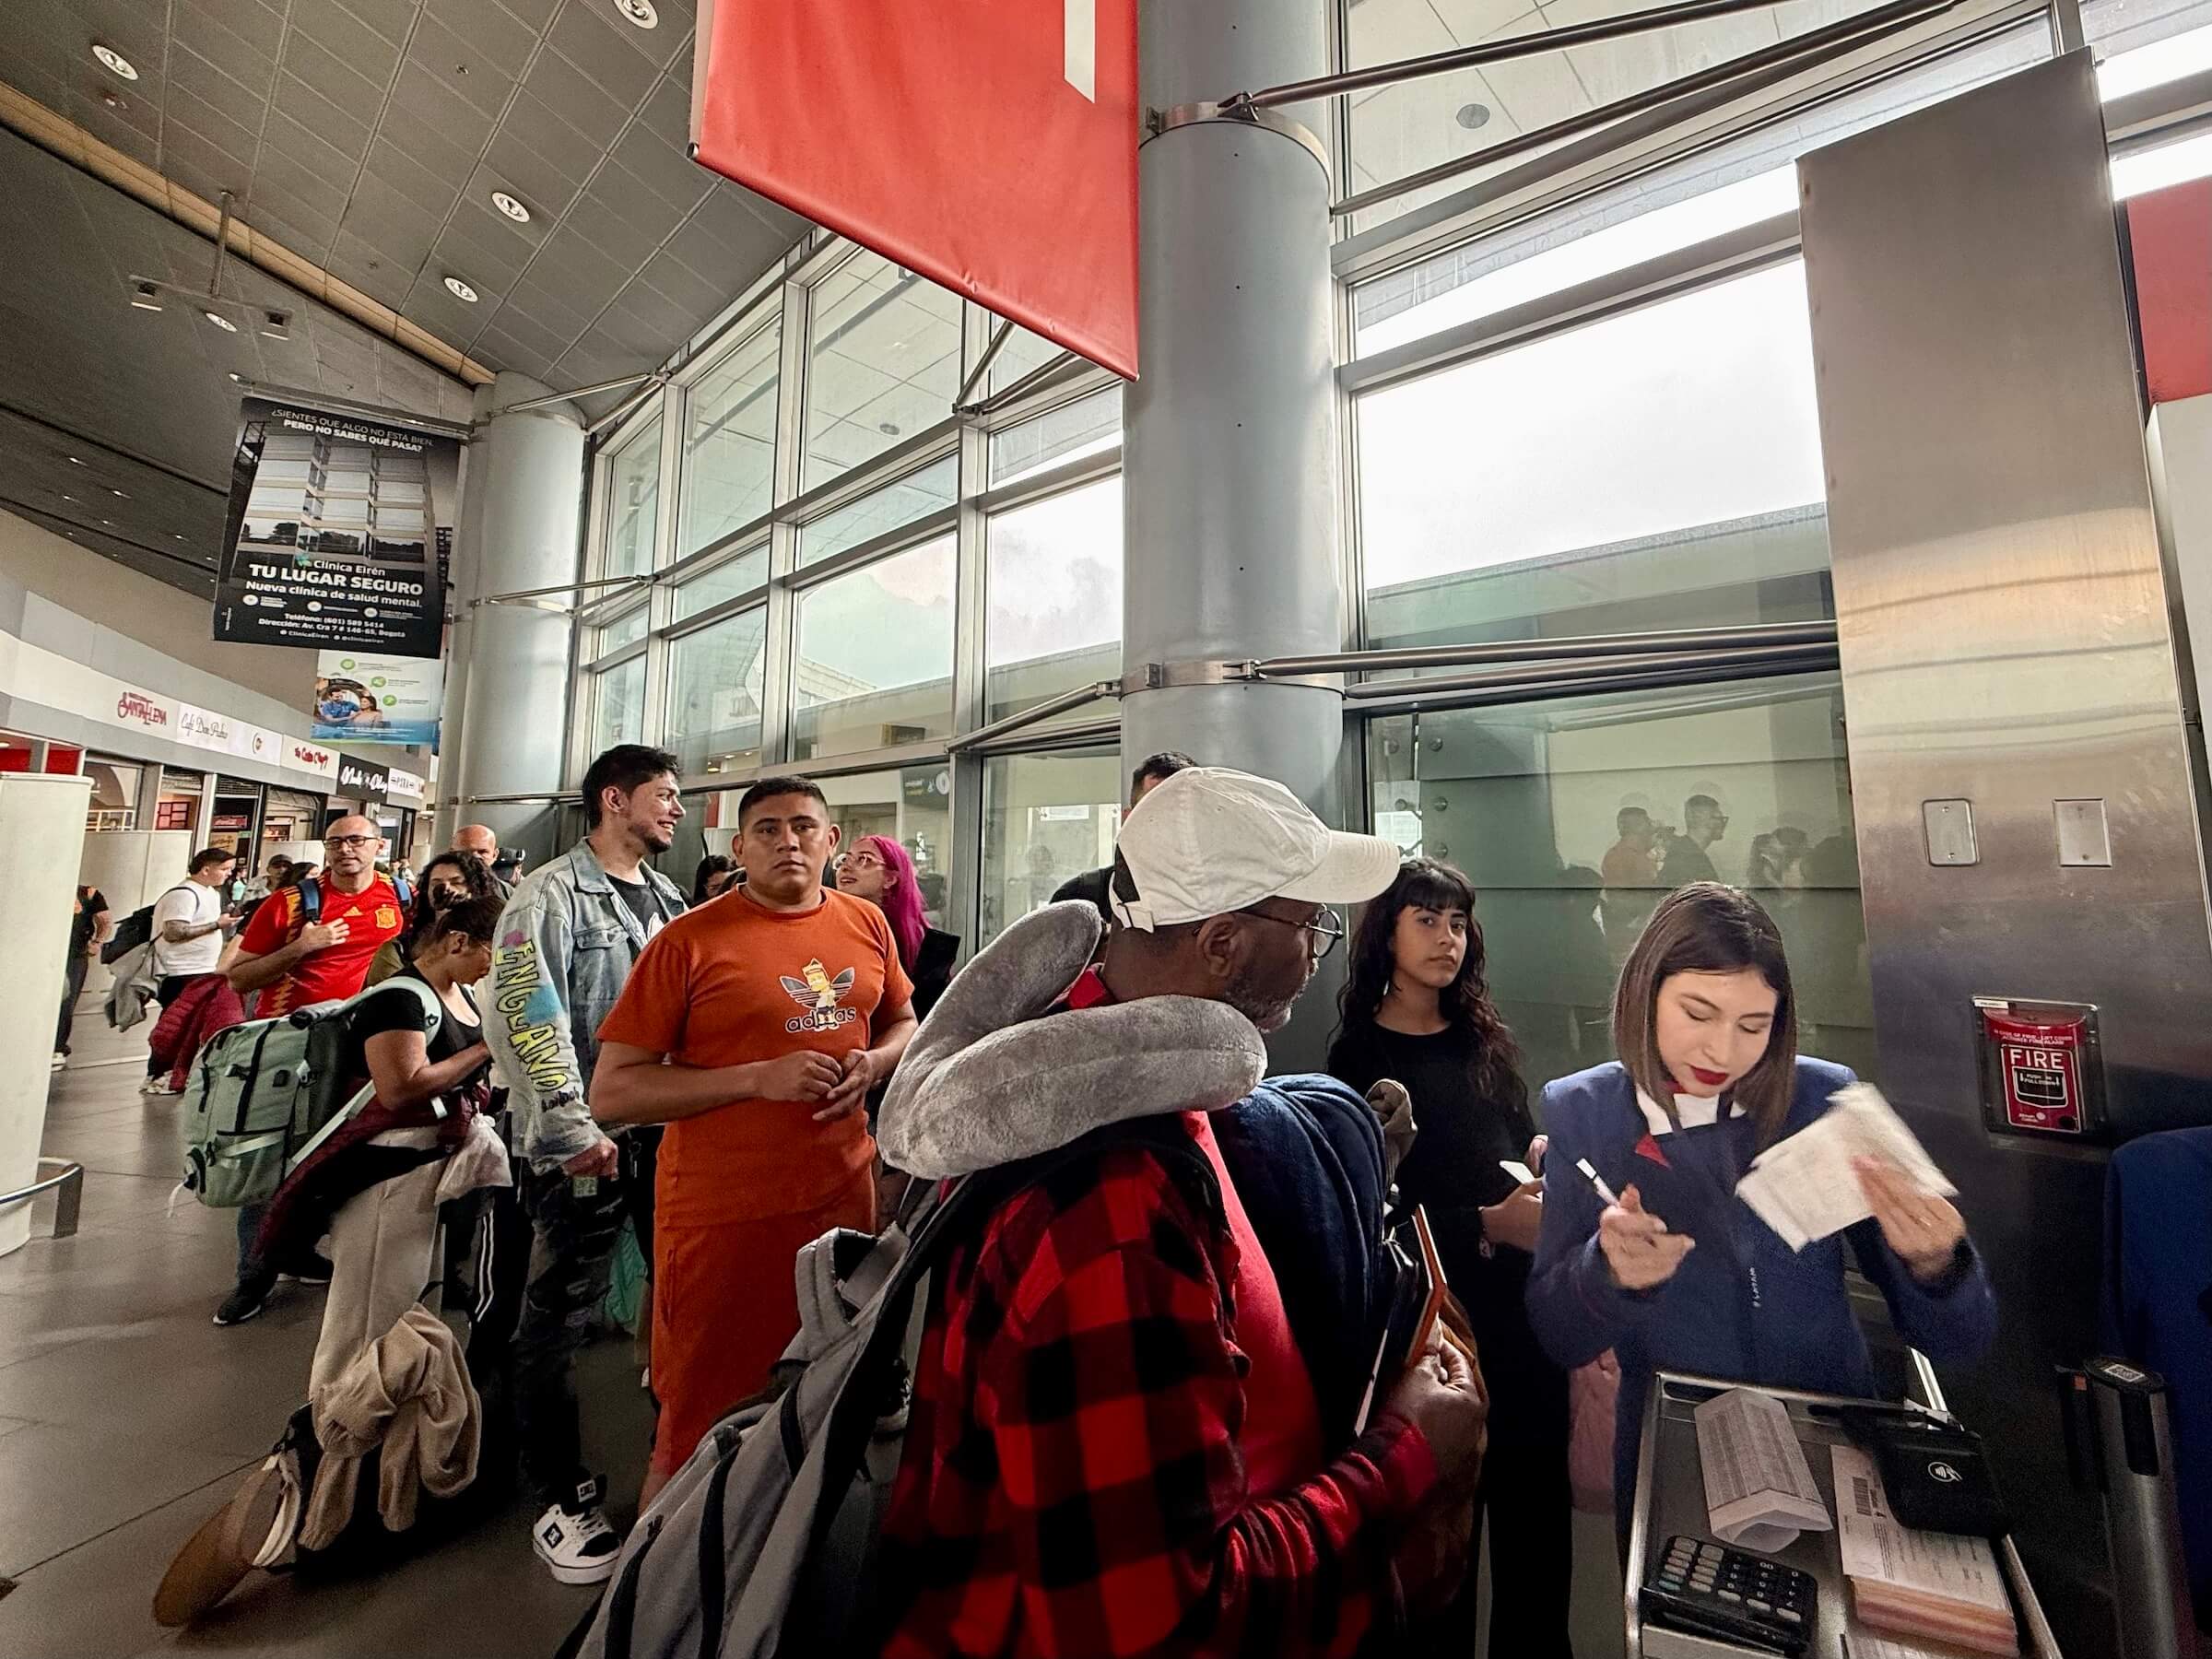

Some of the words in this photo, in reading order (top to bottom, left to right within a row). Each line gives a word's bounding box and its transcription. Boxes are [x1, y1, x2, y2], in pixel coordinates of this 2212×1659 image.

[283, 418, 313, 432] PERO
[315, 425, 332, 435] NO
[333, 429, 367, 441] SABES
[392, 440, 422, 453] PASA?
[342, 423, 369, 433] ALGO
[370, 428, 385, 437] NO
[248, 563, 276, 579] TU
[280, 568, 347, 587] LUGAR
[350, 576, 423, 595] SEGURO
[313, 560, 352, 572] Clínica
[355, 565, 385, 576] Eirén
[246, 581, 288, 594] Nueva
[288, 585, 327, 597] clínica
[330, 590, 346, 599] de
[347, 593, 379, 603] salud
[381, 596, 423, 608] mental.
[495, 939, 571, 1093] ENGLAND
[785, 1007, 856, 1033] adas
[2010, 1049, 2065, 1069] FIRE
